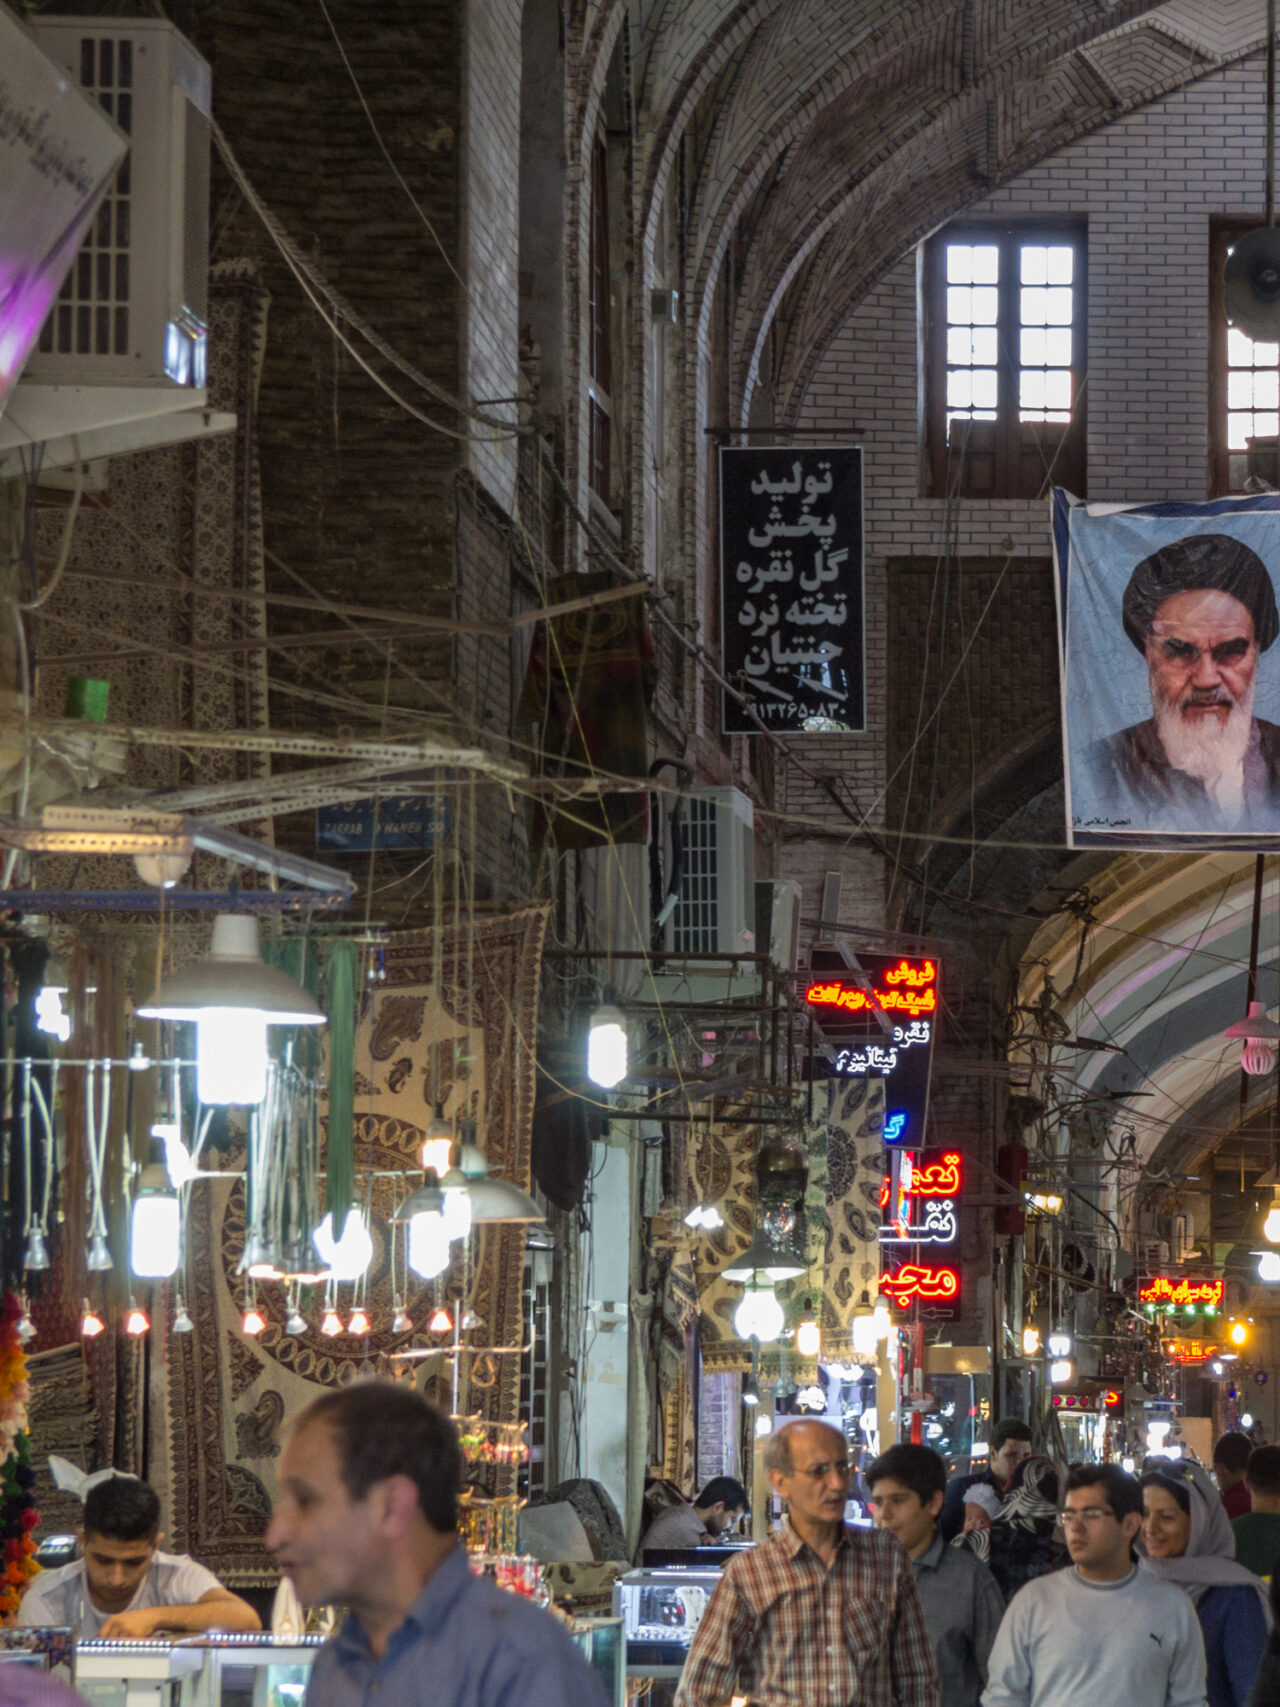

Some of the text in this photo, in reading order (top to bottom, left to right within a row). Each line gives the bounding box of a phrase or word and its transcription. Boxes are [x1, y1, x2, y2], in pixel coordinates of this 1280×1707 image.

[750, 461, 833, 503] تولید
[748, 505, 837, 550] پخش
[735, 547, 849, 593] گل نقره
[737, 592, 848, 636] تخته نرد
